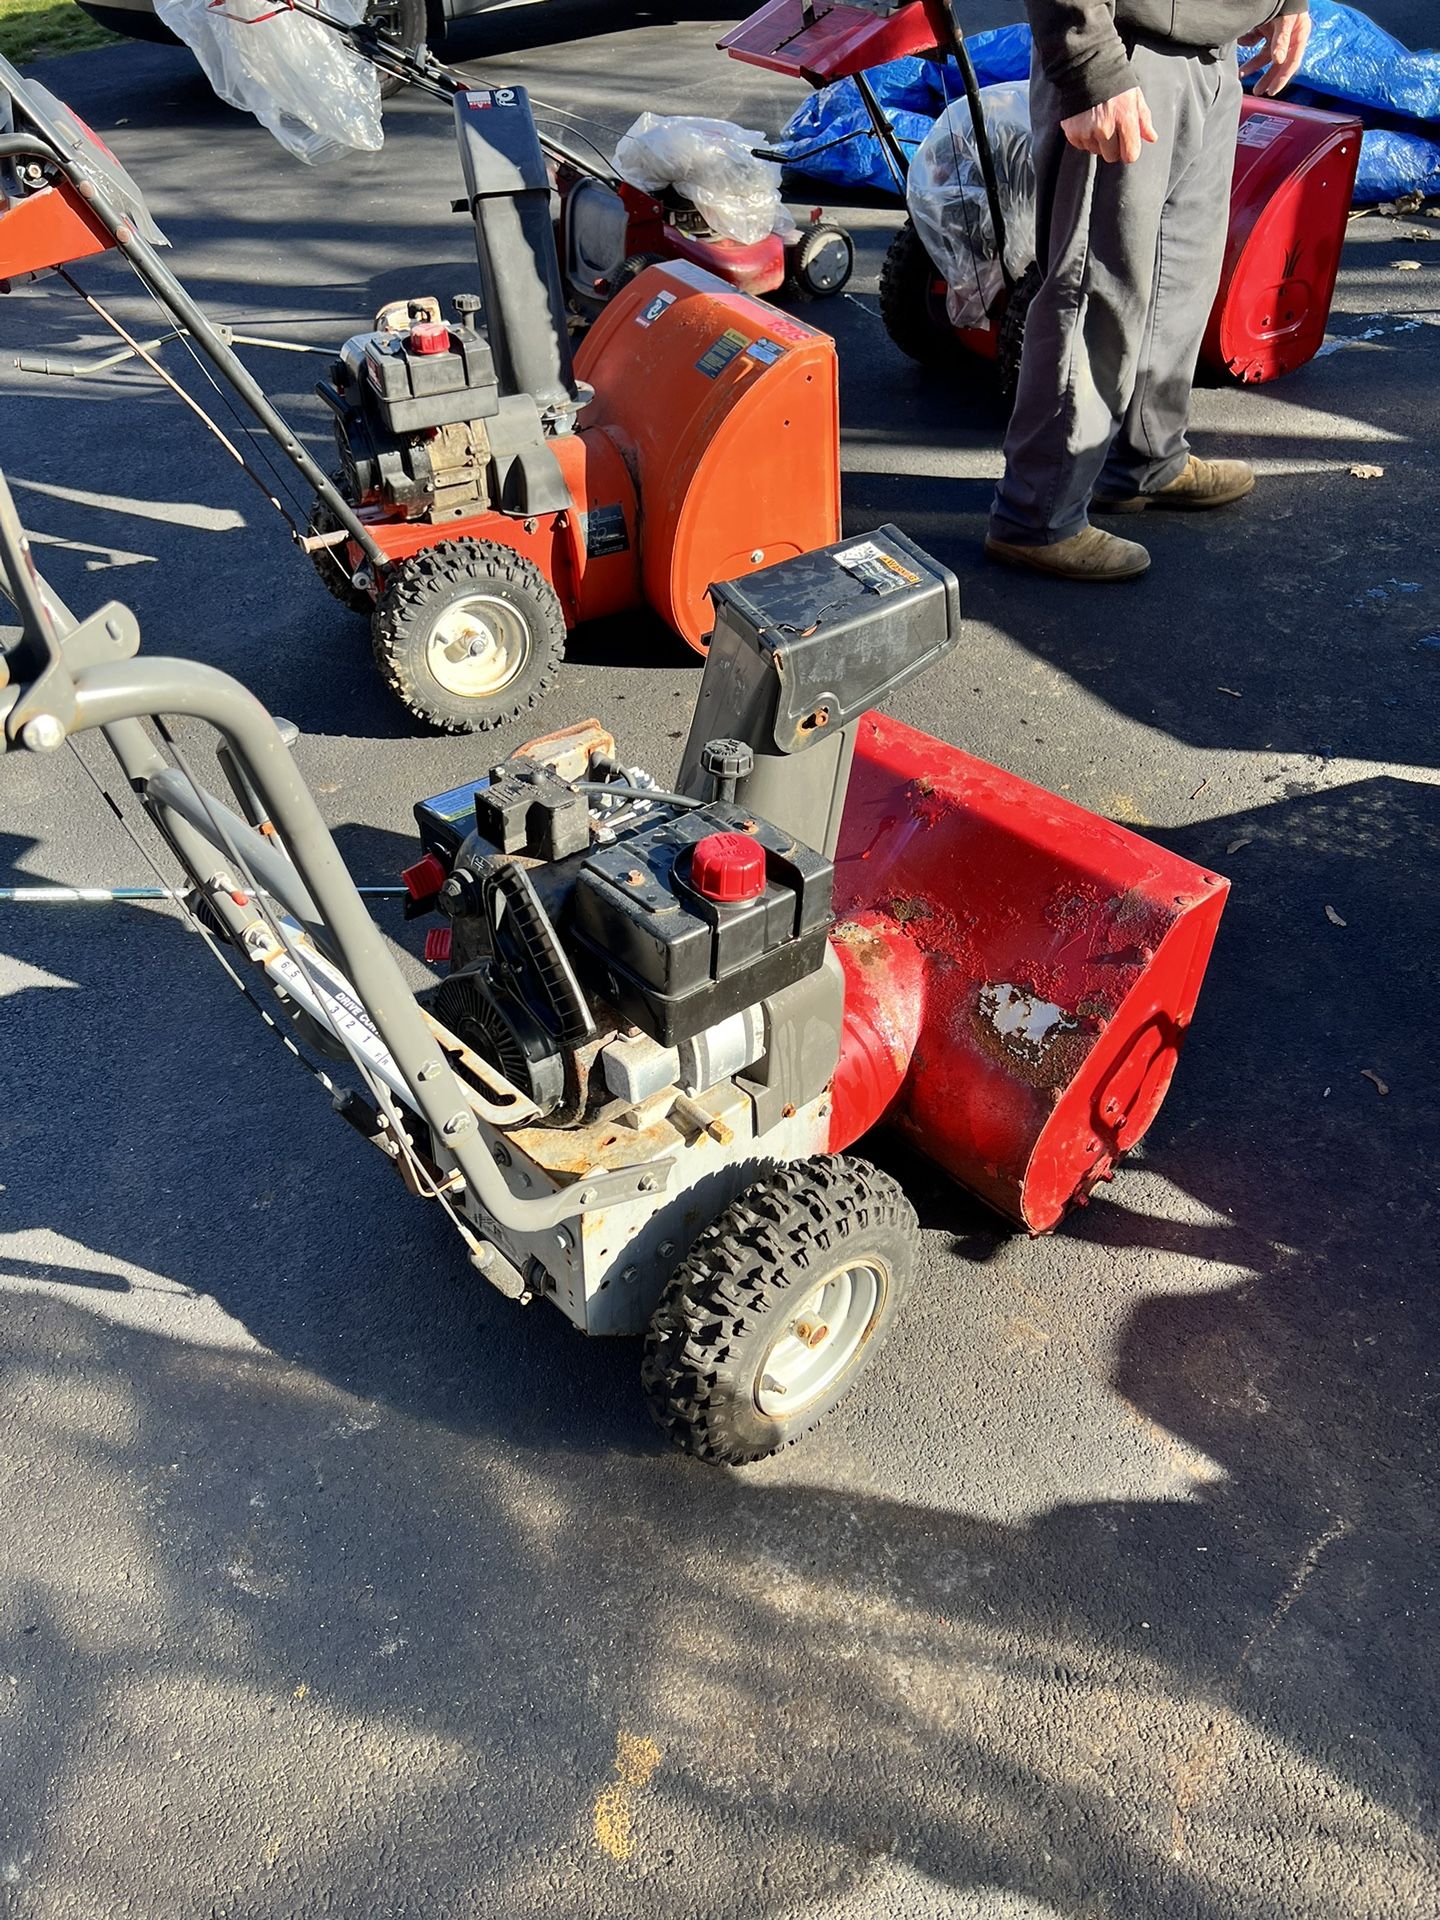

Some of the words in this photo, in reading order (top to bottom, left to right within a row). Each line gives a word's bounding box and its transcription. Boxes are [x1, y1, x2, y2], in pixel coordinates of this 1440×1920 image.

[291, 970, 300, 978] 5
[330, 1006, 339, 1014] 3
[346, 1020, 355, 1029] 2
[362, 1035, 371, 1043] 1
[334, 992, 361, 1016] DRIVE
